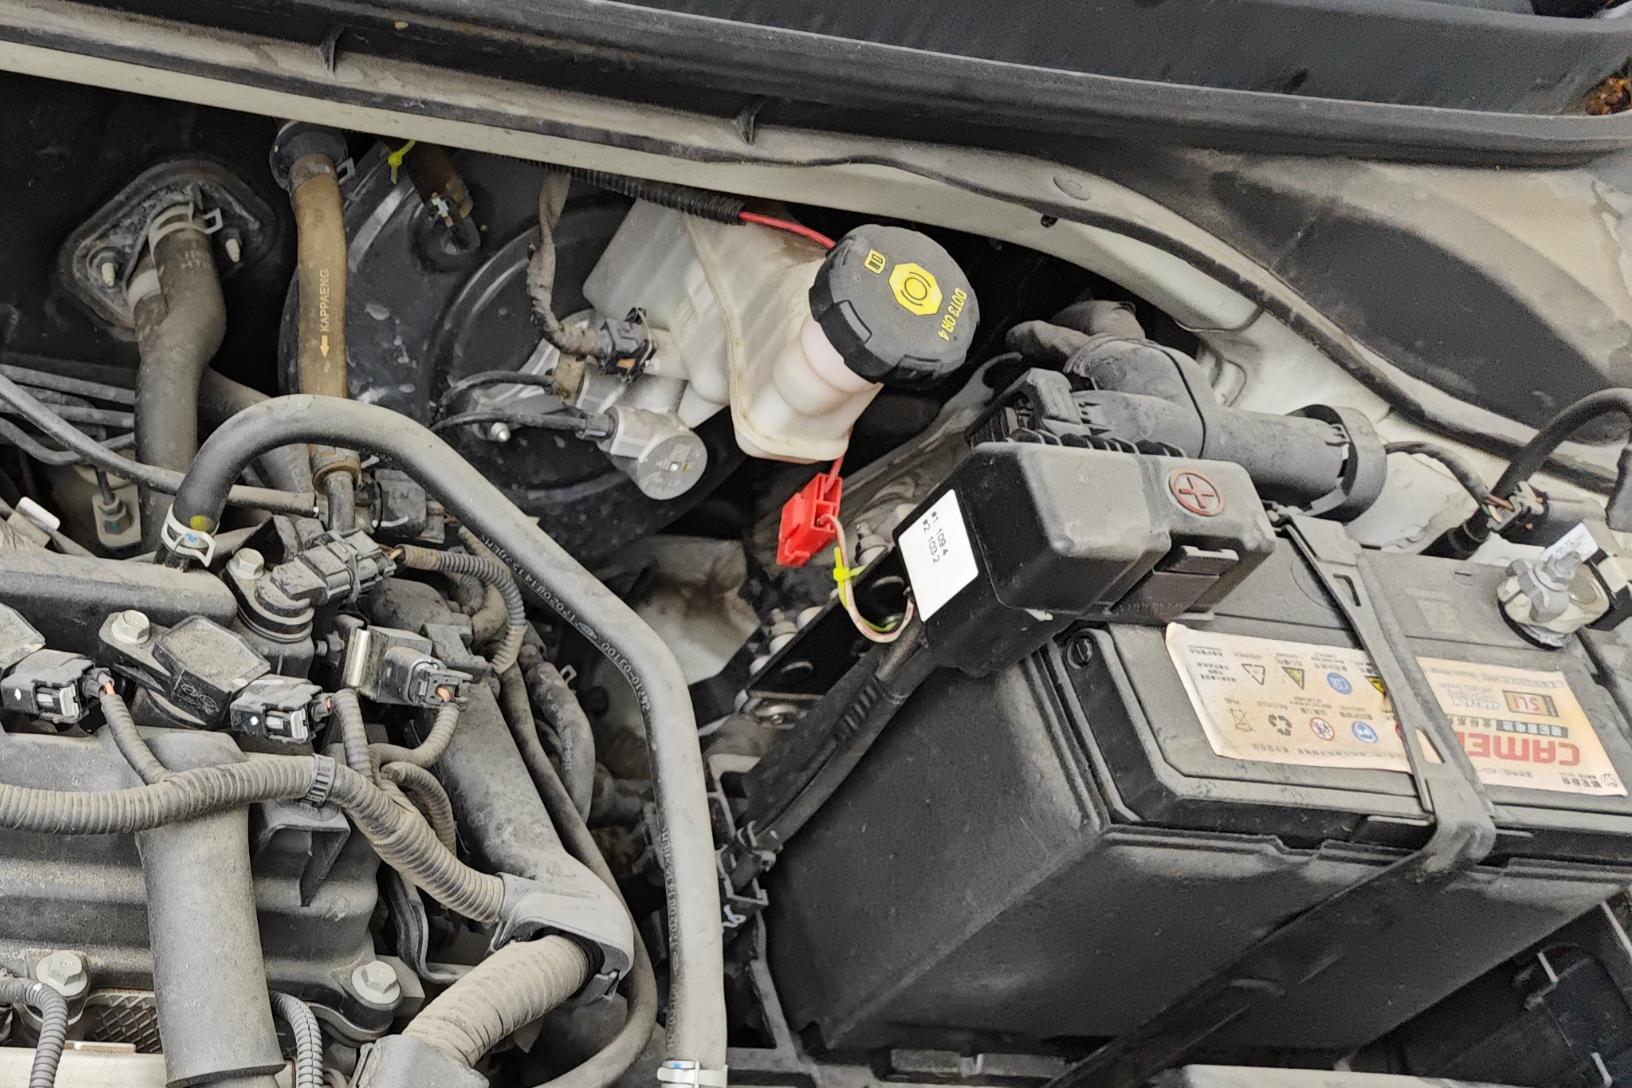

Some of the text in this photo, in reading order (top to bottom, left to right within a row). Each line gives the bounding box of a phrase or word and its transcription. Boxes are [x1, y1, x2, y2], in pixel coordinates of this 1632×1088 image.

[319, 268, 330, 332] KAPPAENG
[937, 287, 968, 342] DOT3 OR 4
[1511, 695, 1541, 712] SLI
